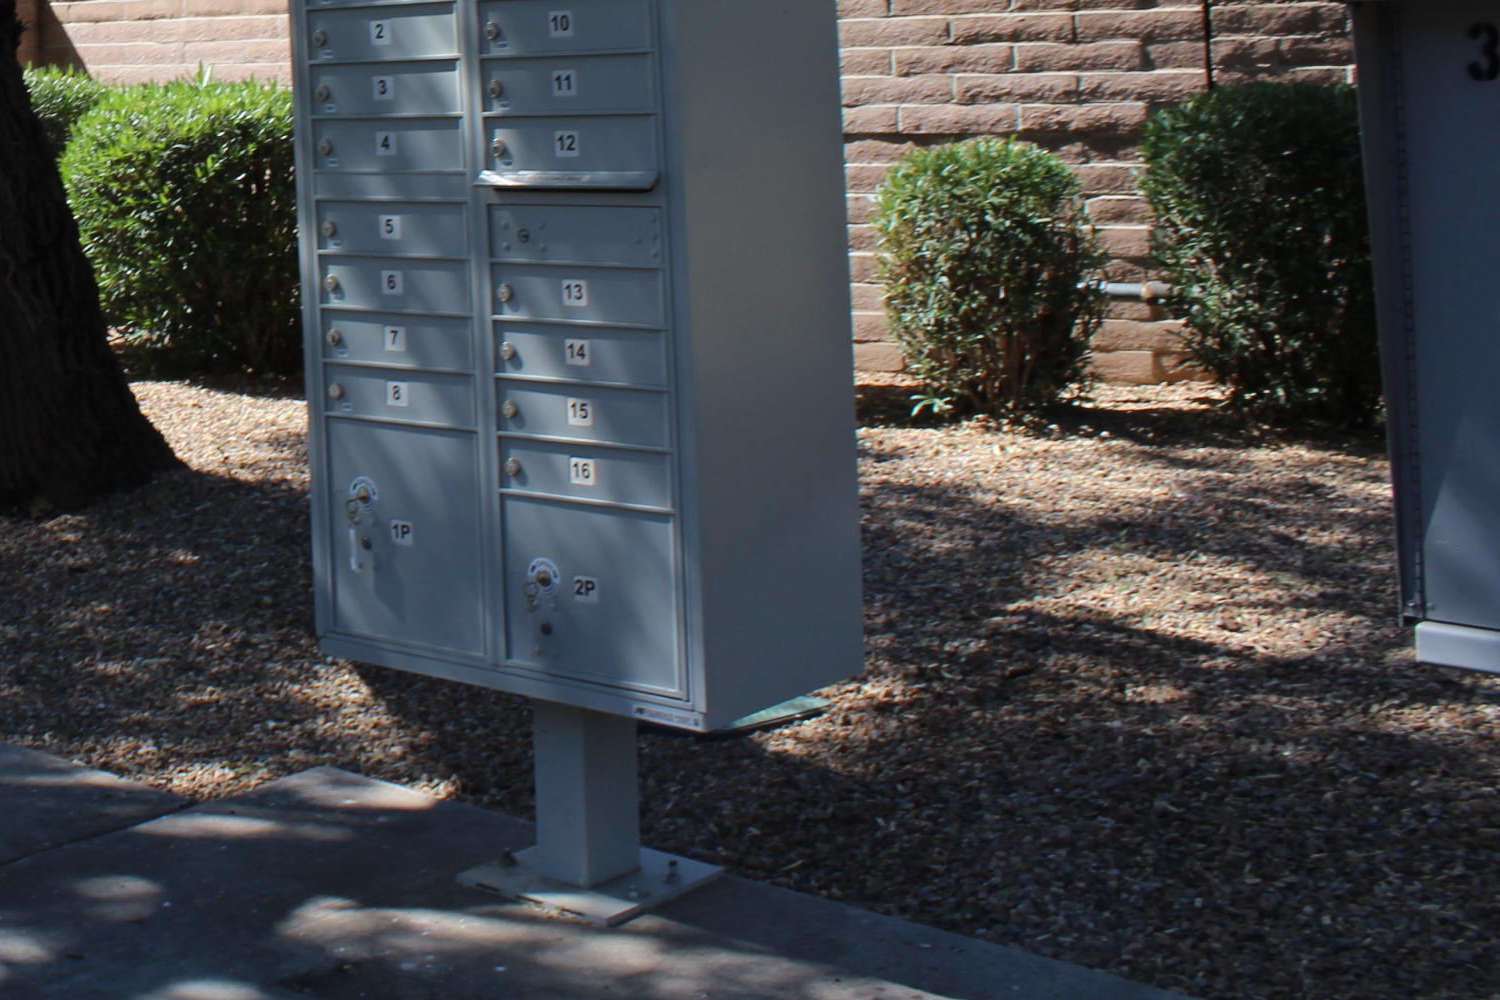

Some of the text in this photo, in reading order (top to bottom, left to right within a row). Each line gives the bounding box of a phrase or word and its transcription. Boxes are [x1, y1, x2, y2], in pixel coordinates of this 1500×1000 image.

[375, 23, 384, 39] 2
[551, 14, 570, 32] 10
[378, 79, 387, 95] 3
[554, 74, 571, 90] 11
[381, 135, 390, 150] 4
[557, 134, 576, 151] 12
[385, 218, 393, 234] 5
[387, 274, 396, 290] 6
[565, 284, 583, 300] 13
[390, 329, 399, 345] 7
[568, 343, 586, 359] 14
[393, 385, 401, 401] 8
[571, 402, 589, 419] 15
[573, 463, 590, 479] 16
[392, 524, 411, 539] 1P
[575, 579, 595, 596] 2P
